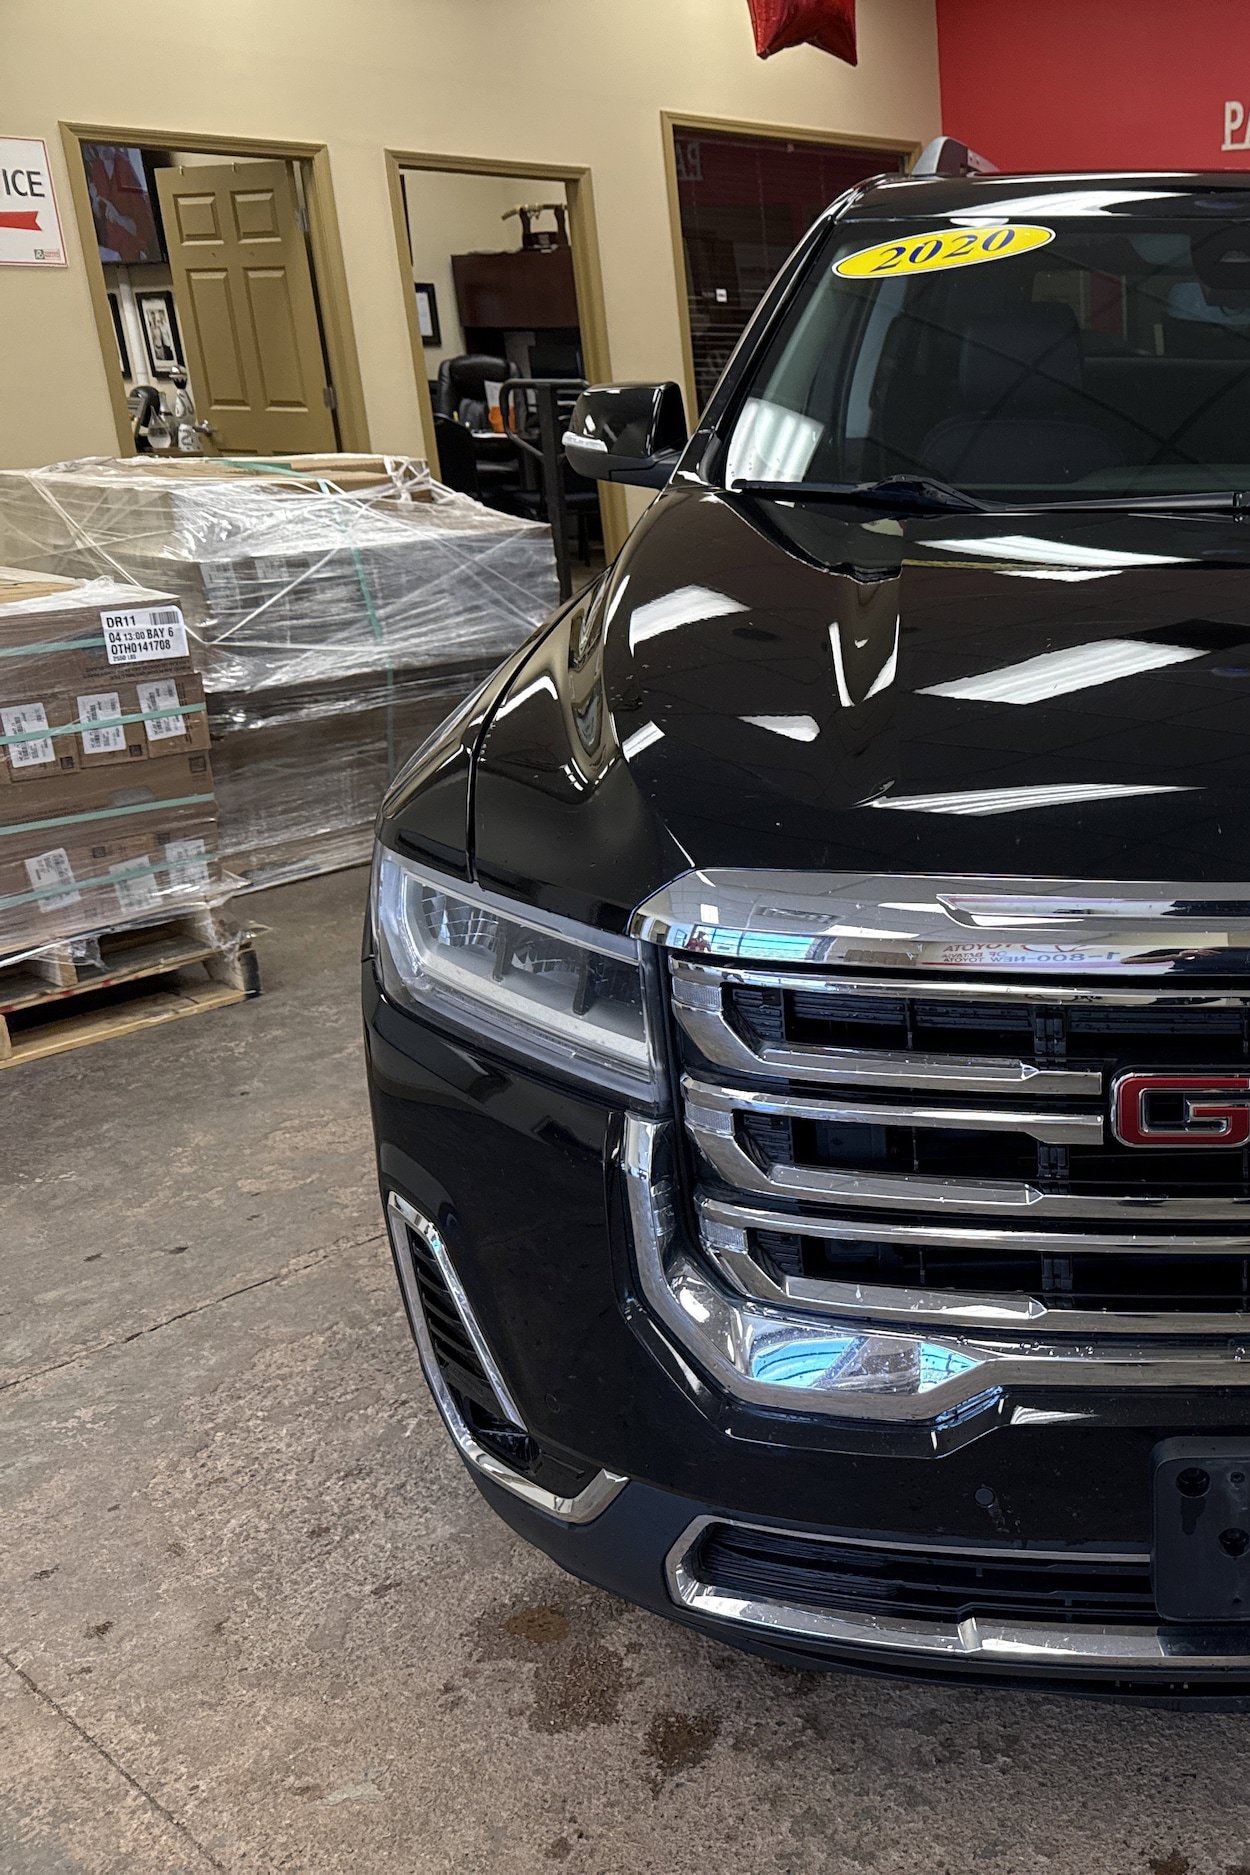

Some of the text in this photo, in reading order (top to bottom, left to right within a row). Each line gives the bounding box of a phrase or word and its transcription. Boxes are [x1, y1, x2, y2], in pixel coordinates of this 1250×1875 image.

[2, 168, 45, 197] ICE
[870, 229, 1015, 272] 2020
[106, 615, 136, 628] DR11
[109, 627, 174, 643] 04 13:00 BAY 6
